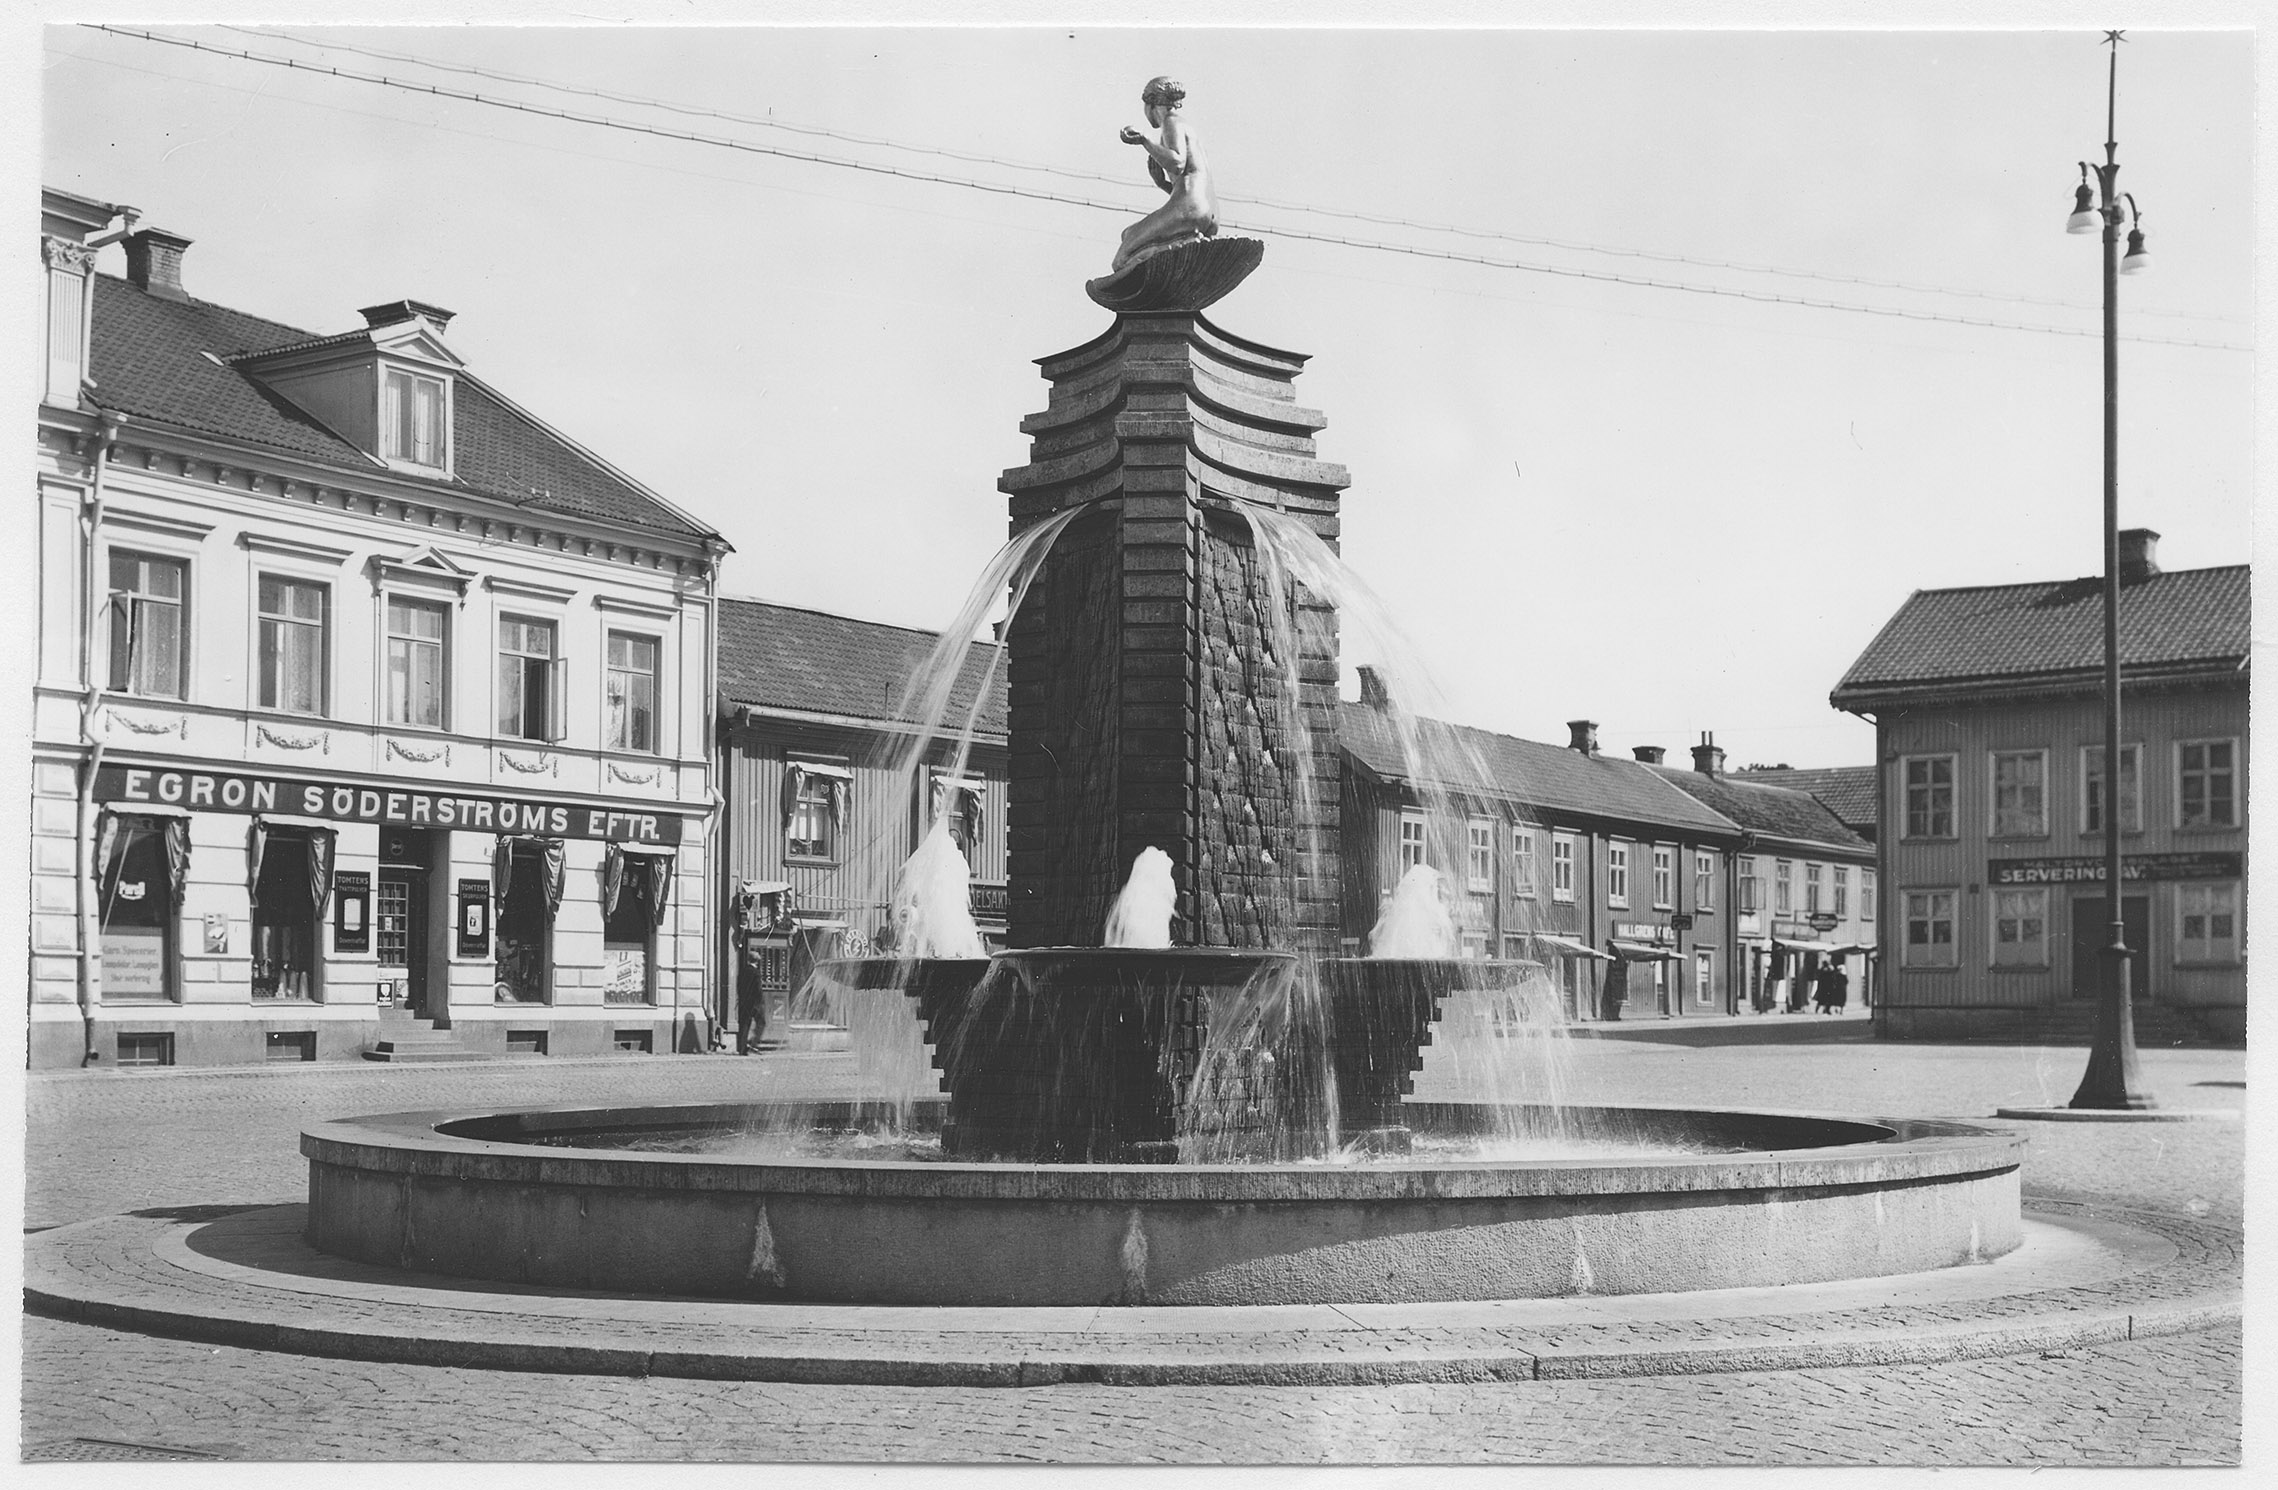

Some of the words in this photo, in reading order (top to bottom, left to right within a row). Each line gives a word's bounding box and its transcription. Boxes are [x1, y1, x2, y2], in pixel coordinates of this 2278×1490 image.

[124, 769, 277, 809] EGRON
[302, 785, 569, 833] SÖDERSTRÖMS
[588, 810, 661, 841] EFTR.
[337, 876, 369, 885] TOMTENS
[2000, 867, 2106, 883] SERVERING
